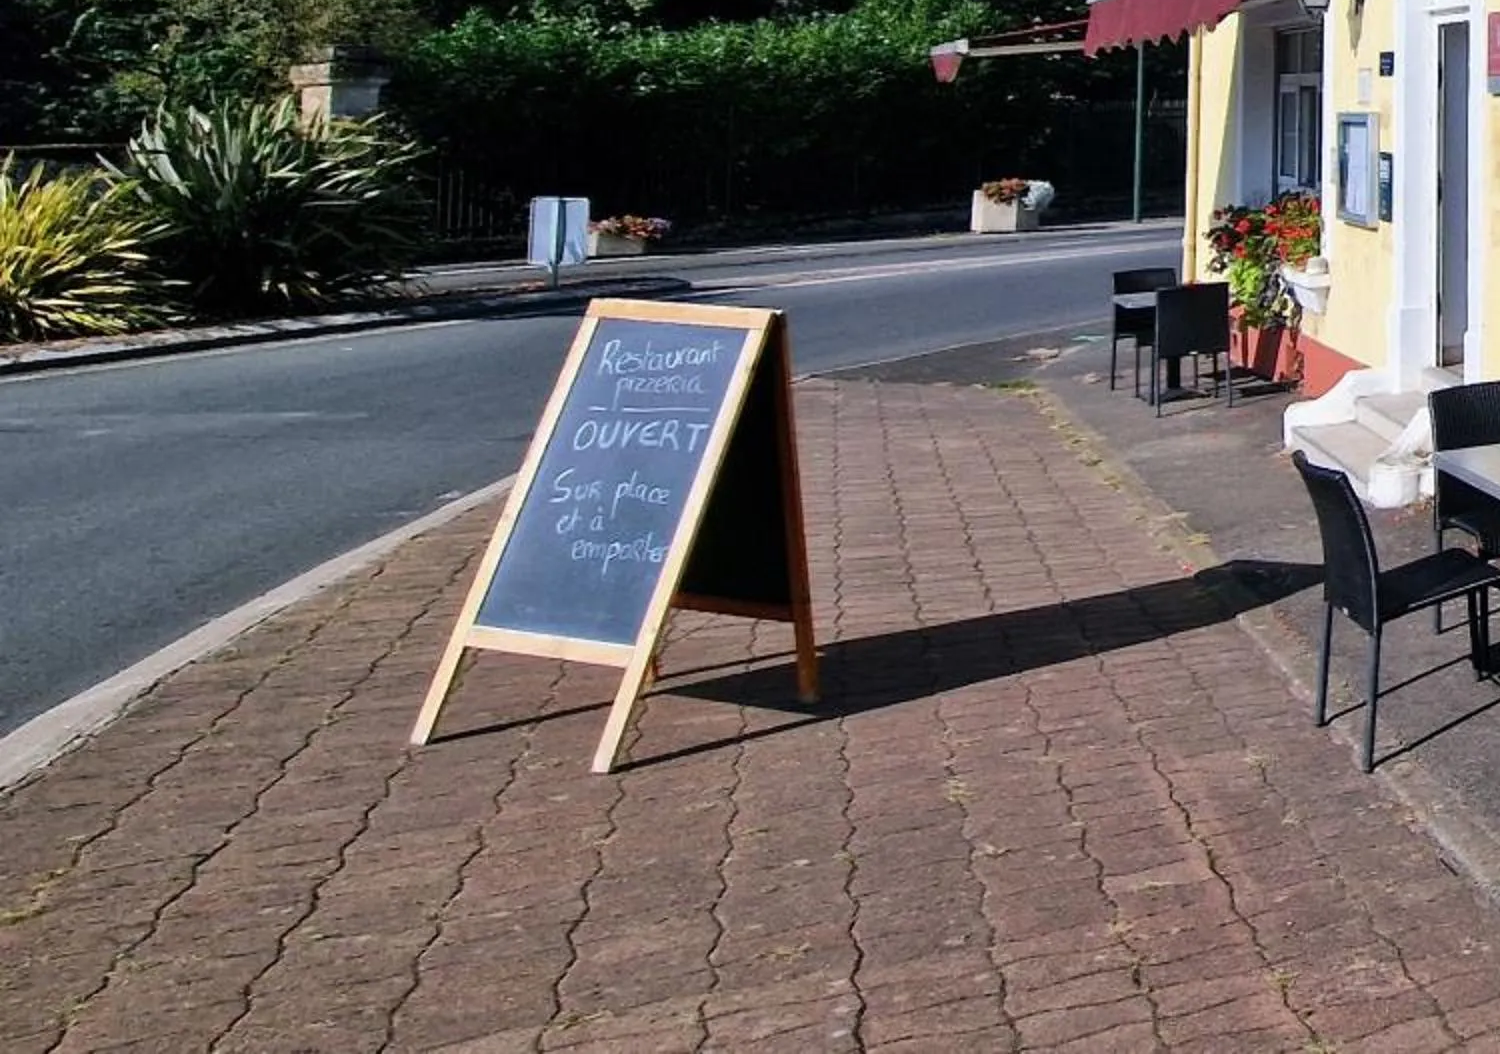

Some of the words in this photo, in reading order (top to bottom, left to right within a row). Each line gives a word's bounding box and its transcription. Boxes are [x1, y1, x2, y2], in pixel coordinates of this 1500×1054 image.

[598, 339, 723, 375] Restaurant
[574, 419, 710, 453] OUVERT
[610, 470, 670, 520] place
[556, 507, 582, 534] et
